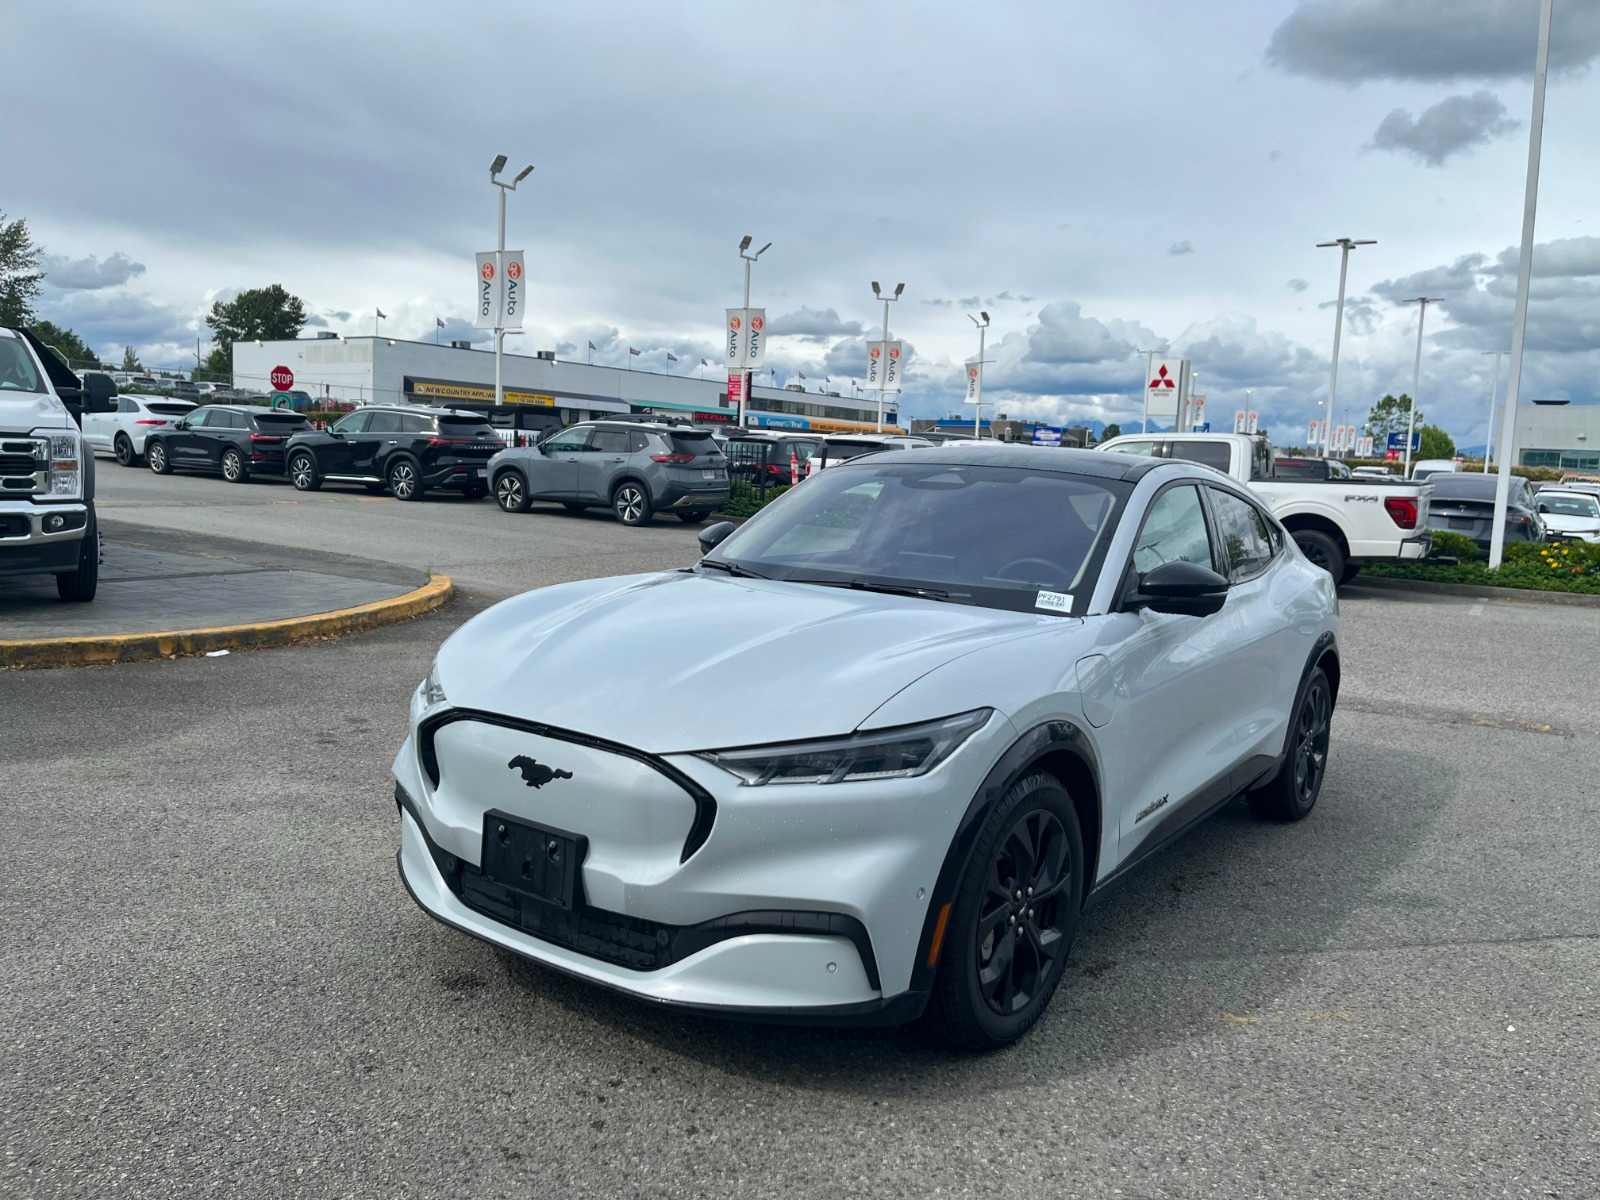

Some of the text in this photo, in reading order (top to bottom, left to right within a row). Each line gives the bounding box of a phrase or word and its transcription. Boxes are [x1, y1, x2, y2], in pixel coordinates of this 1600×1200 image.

[482, 281, 491, 316] Auto
[508, 280, 518, 315] Auto
[729, 330, 738, 357] Auto
[751, 330, 760, 357] Auto
[272, 372, 293, 385] STOP
